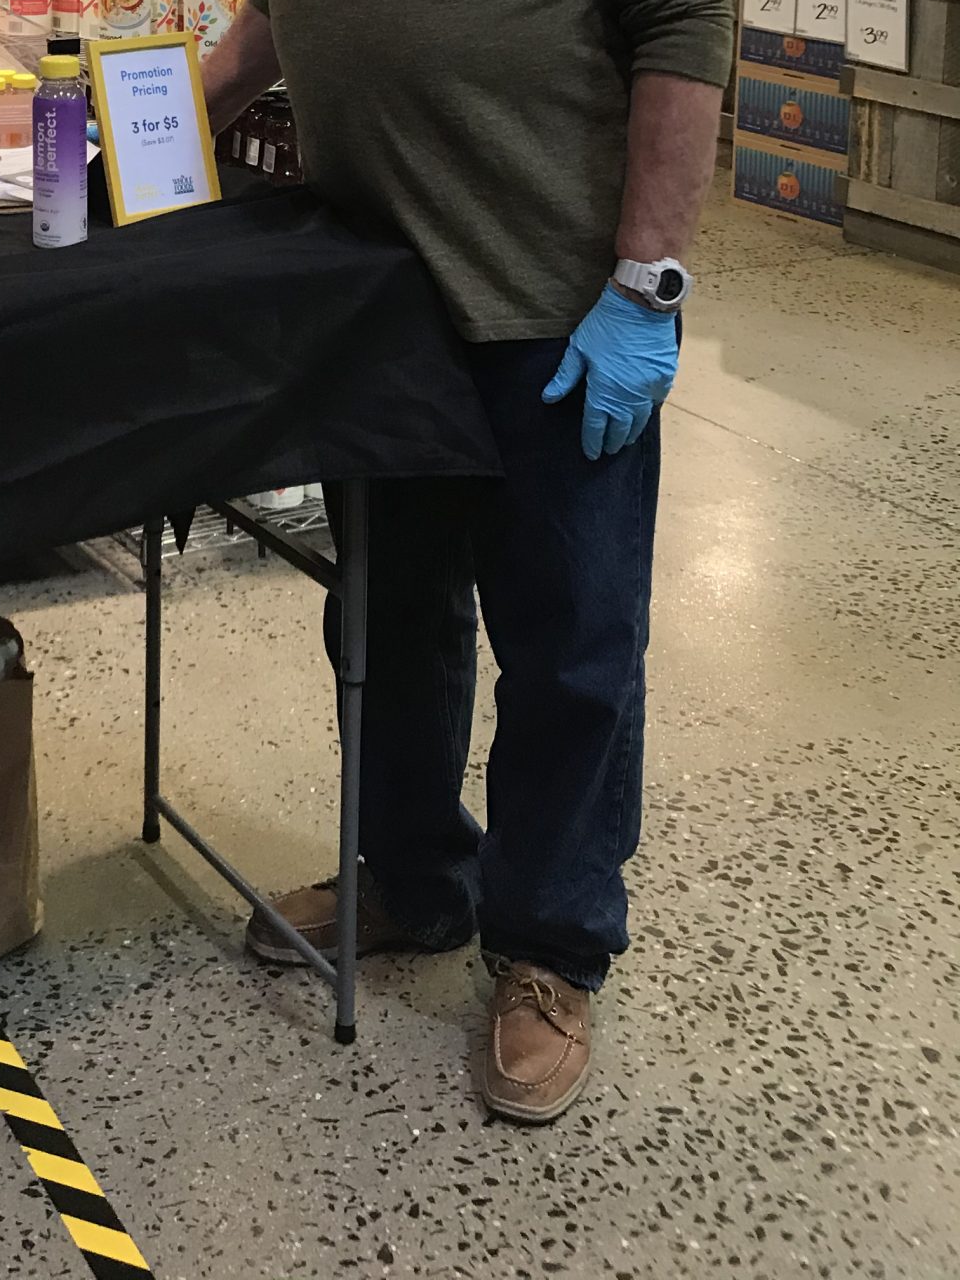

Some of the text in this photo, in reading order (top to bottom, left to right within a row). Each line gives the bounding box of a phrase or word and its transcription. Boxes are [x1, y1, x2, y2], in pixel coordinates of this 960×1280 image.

[120, 66, 173, 82] Promotion
[132, 83, 168, 96] Pricing
[131, 116, 179, 134] 3 for $5
[35, 122, 45, 170] lemon
[45, 107, 59, 173] perfect.
